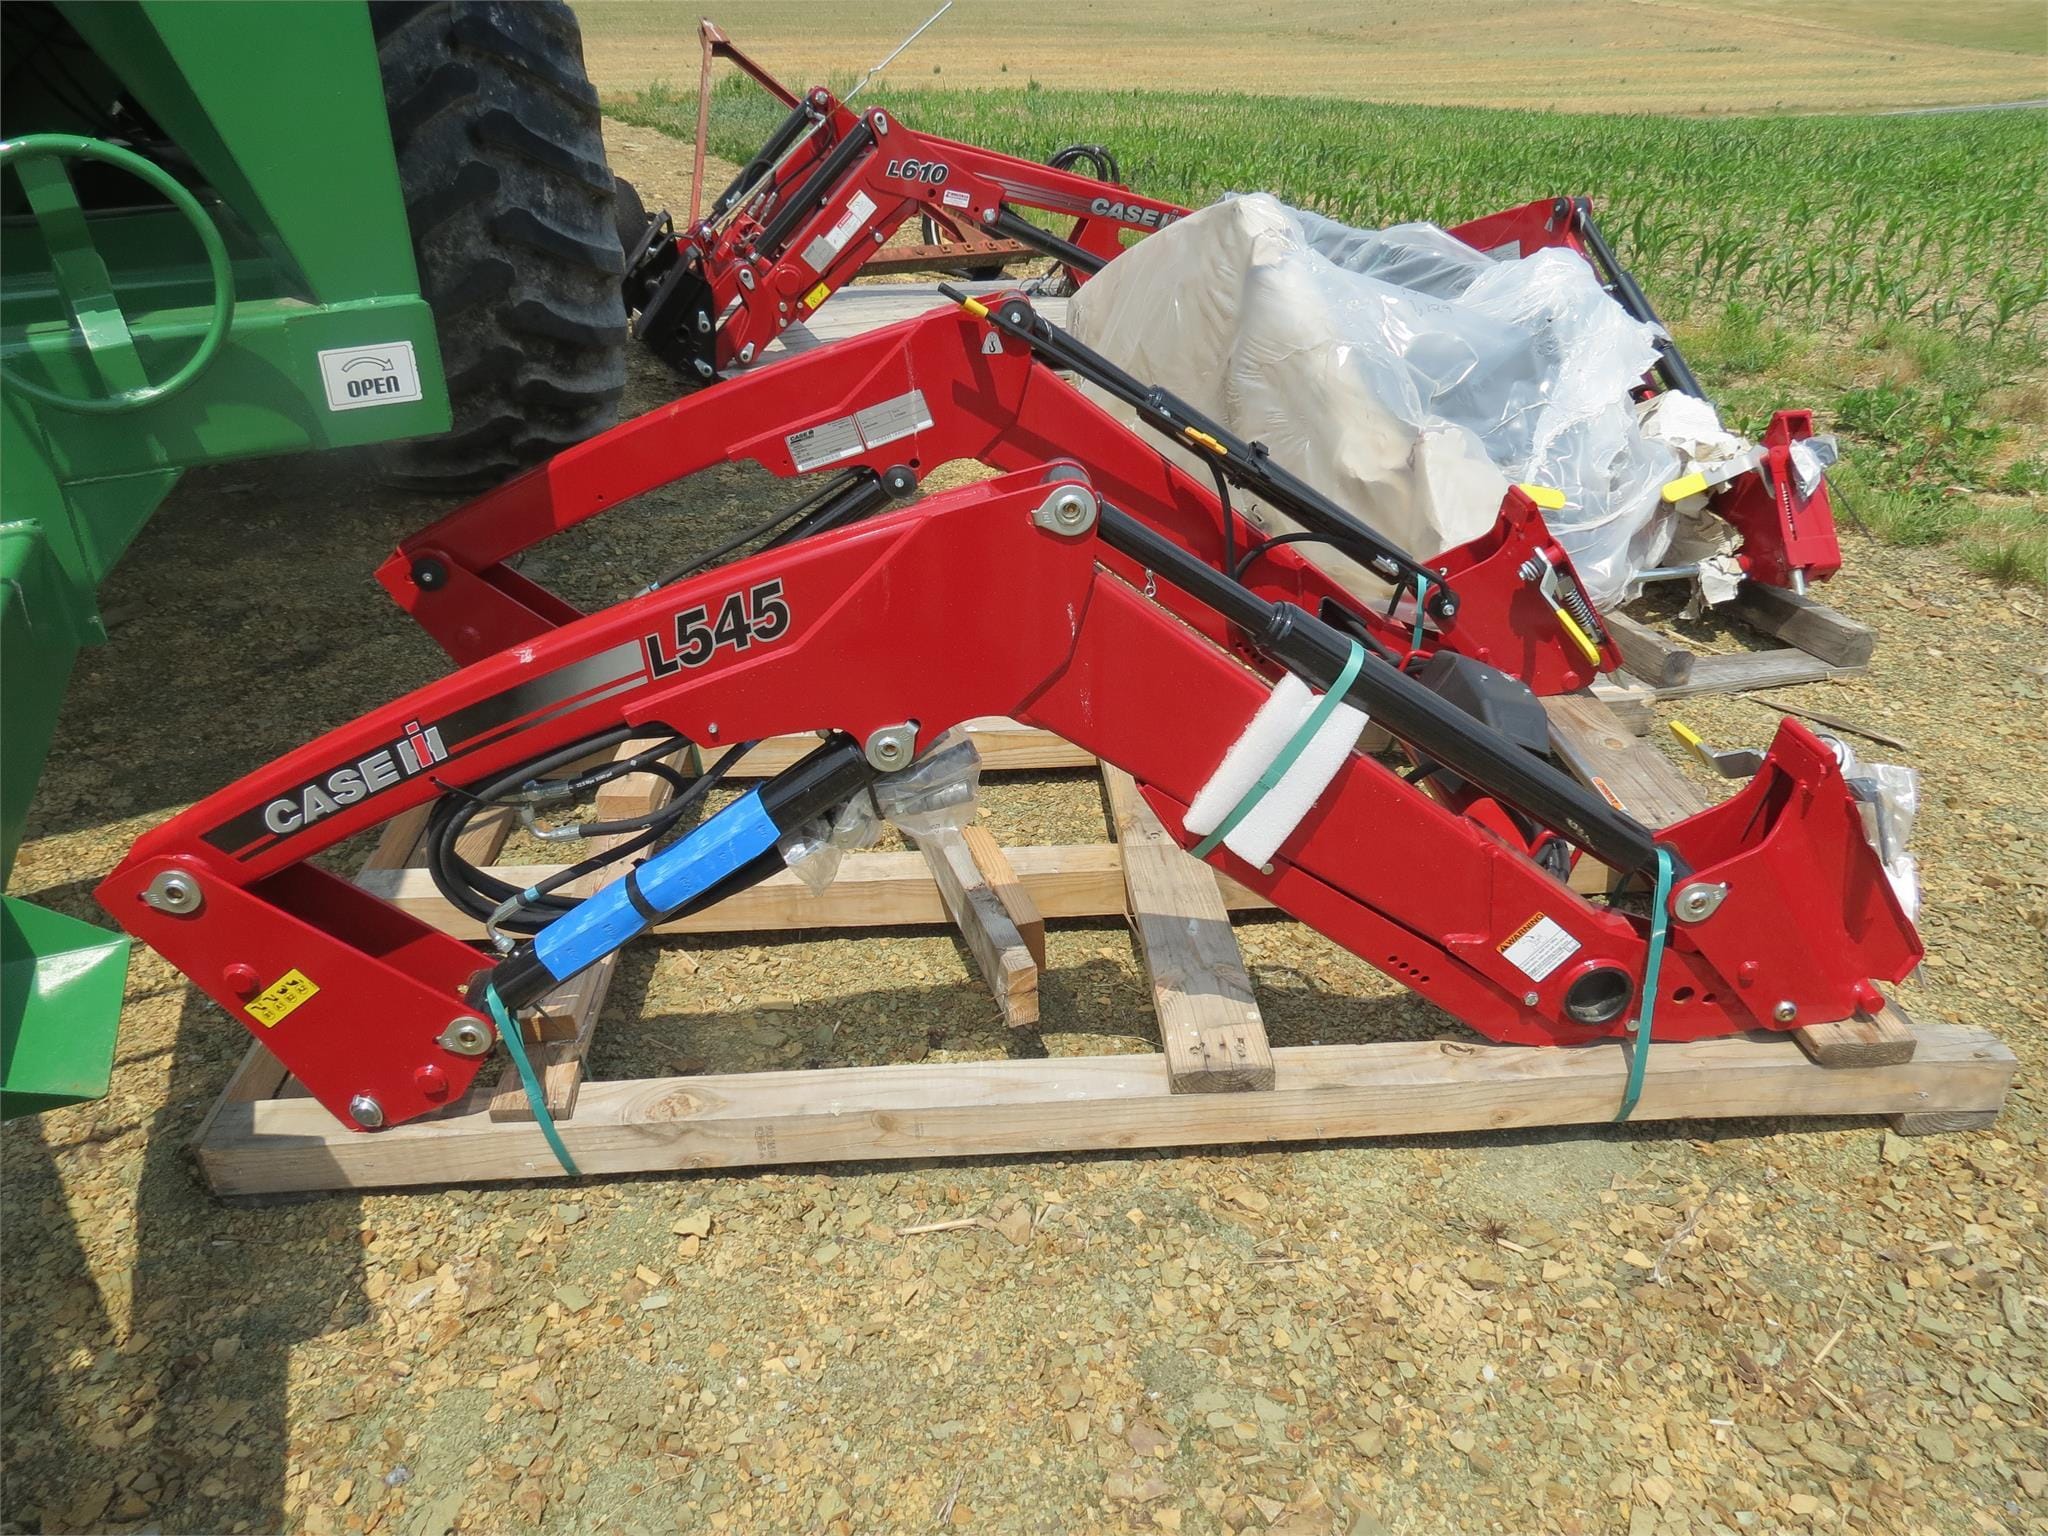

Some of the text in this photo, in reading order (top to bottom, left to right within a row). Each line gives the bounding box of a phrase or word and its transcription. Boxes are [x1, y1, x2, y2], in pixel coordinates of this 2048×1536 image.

[885, 158, 949, 185] L610
[1090, 197, 1159, 228] CASE
[347, 375, 400, 398] OPEN
[644, 577, 791, 681] L545
[264, 750, 401, 834] CASE
[1507, 912, 1545, 946] WARNING
